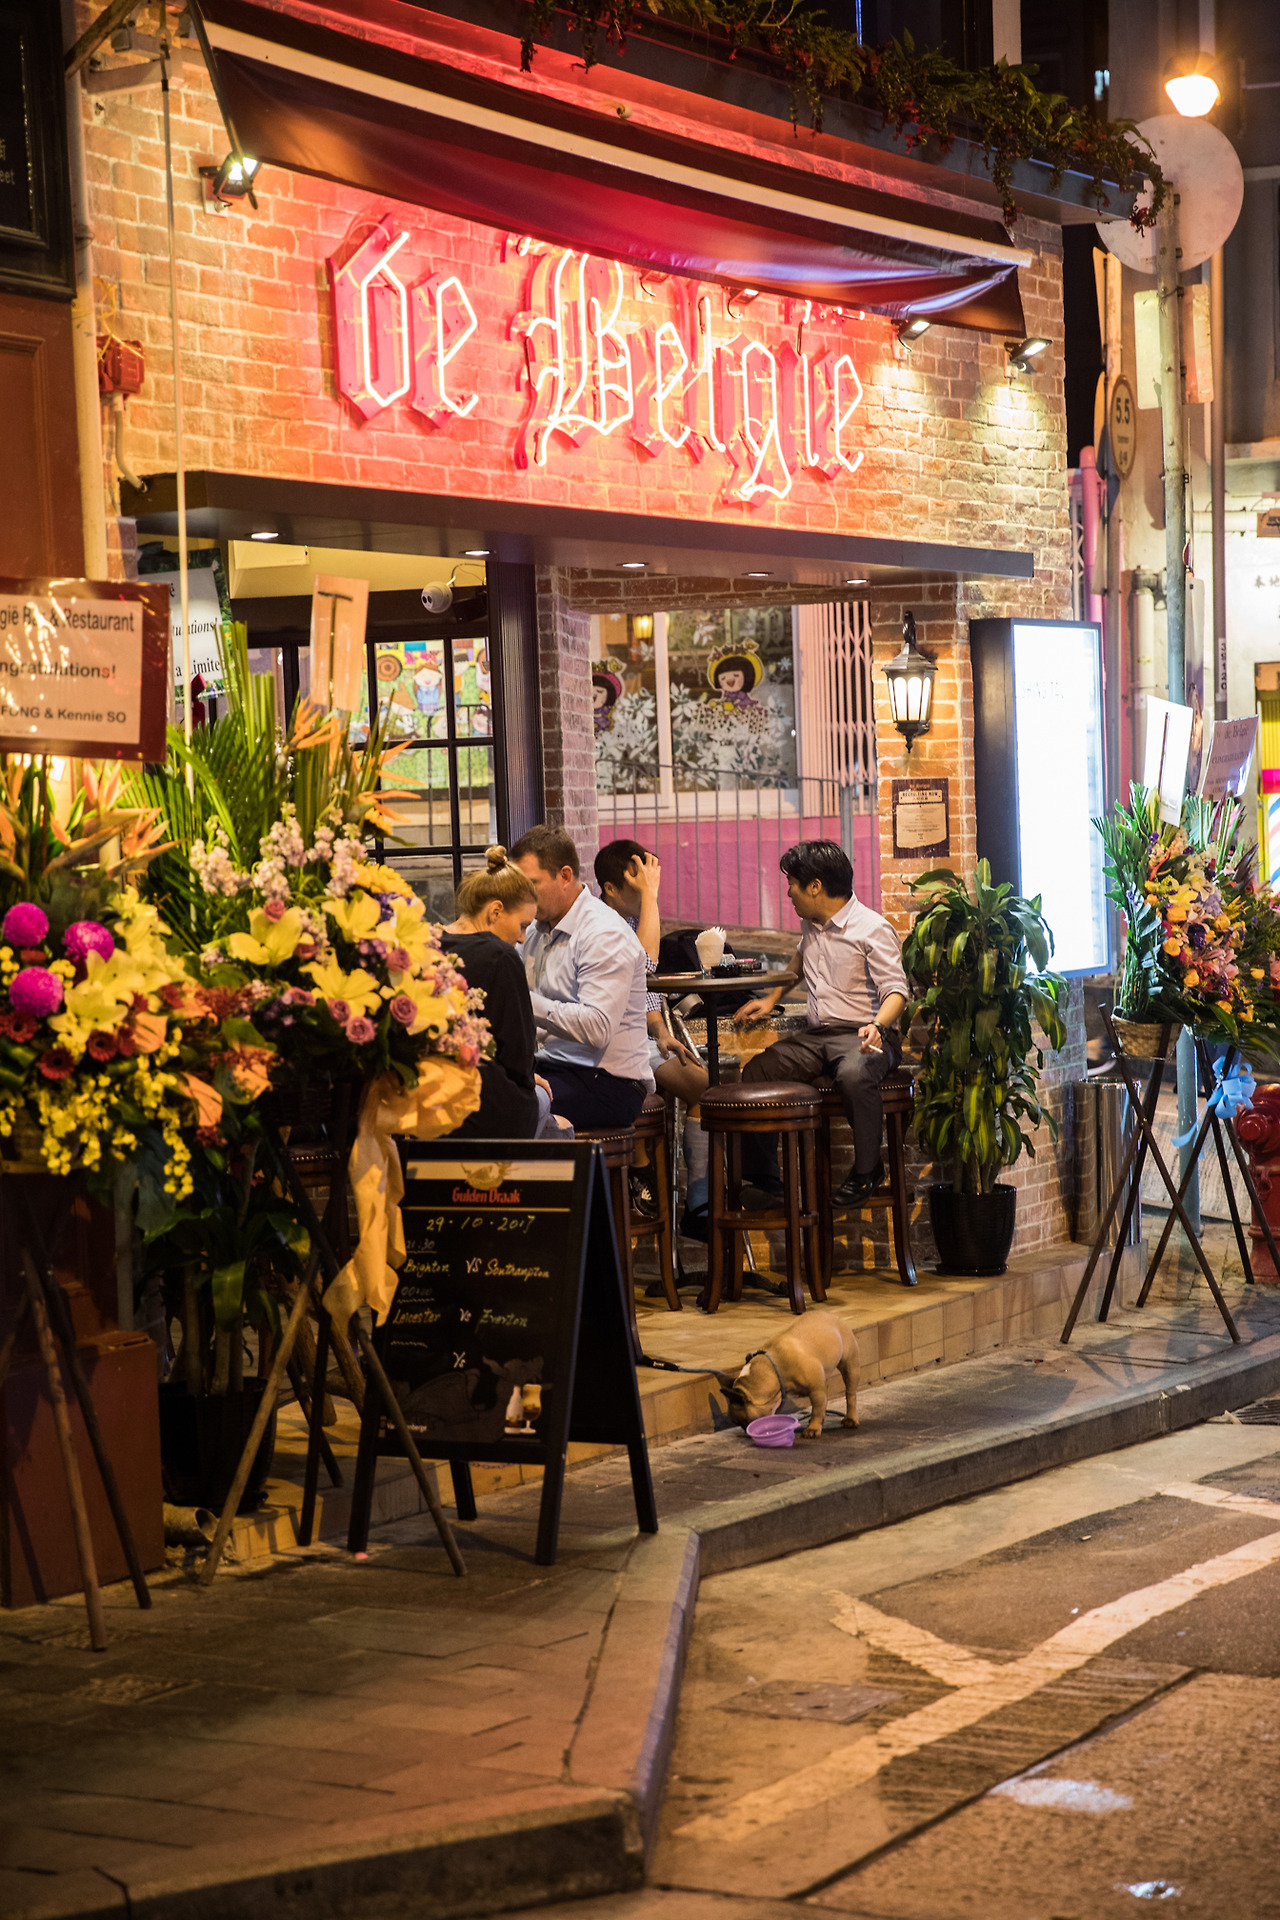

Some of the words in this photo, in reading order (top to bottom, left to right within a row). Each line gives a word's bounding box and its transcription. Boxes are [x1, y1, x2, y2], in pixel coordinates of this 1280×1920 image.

[1115, 397, 1130, 425] 5.5
[62, 608, 135, 632] Restaurant
[44, 707, 54, 719] &
[57, 708, 103, 722] Kennie
[107, 711, 127, 724] SO
[452, 1187, 488, 1203] Gulden
[489, 1187, 520, 1204] Draak
[392, 1308, 442, 1325] Leicester
